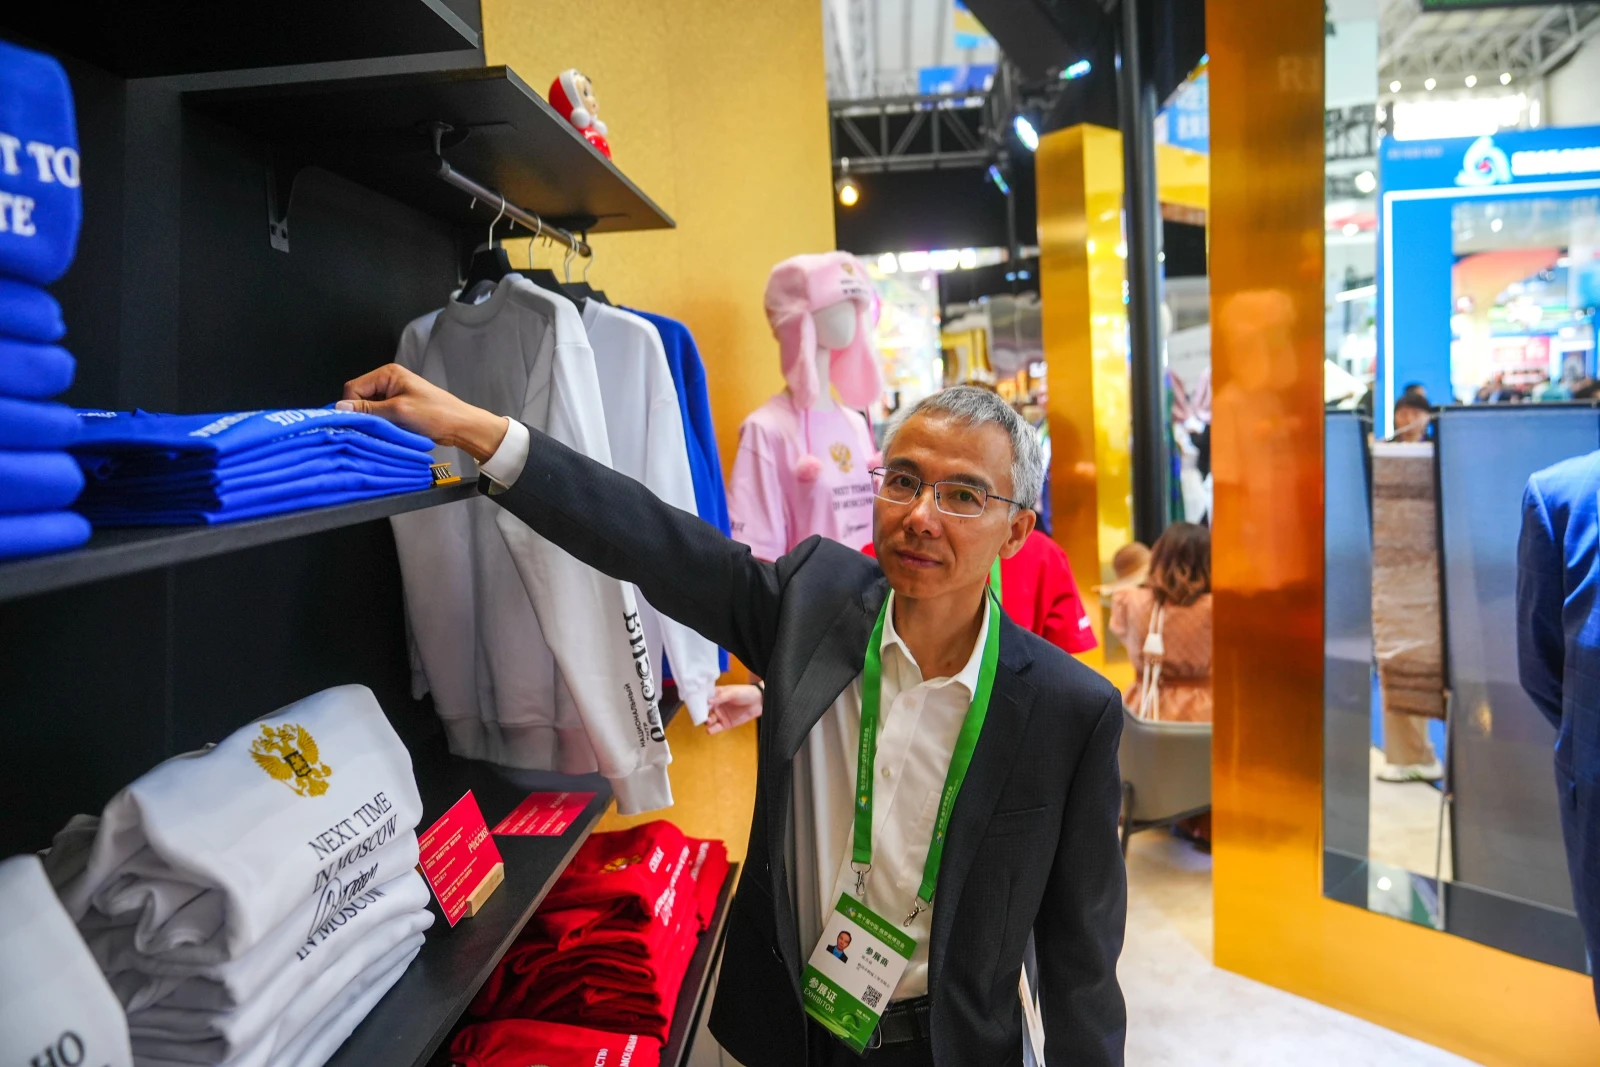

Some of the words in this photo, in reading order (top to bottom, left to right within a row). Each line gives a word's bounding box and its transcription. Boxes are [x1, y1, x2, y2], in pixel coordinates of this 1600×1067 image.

[623, 683, 646, 747] НАЦИОНАЛЬНЫЙ
[308, 818, 360, 861] NEXT
[353, 792, 392, 828] TIME
[312, 861, 335, 895] IN
[334, 814, 398, 876] MOSCOW
[865, 946, 890, 967] 参展商
[803, 987, 836, 1014] EXHIBITOR
[808, 977, 838, 1004] 参展证
